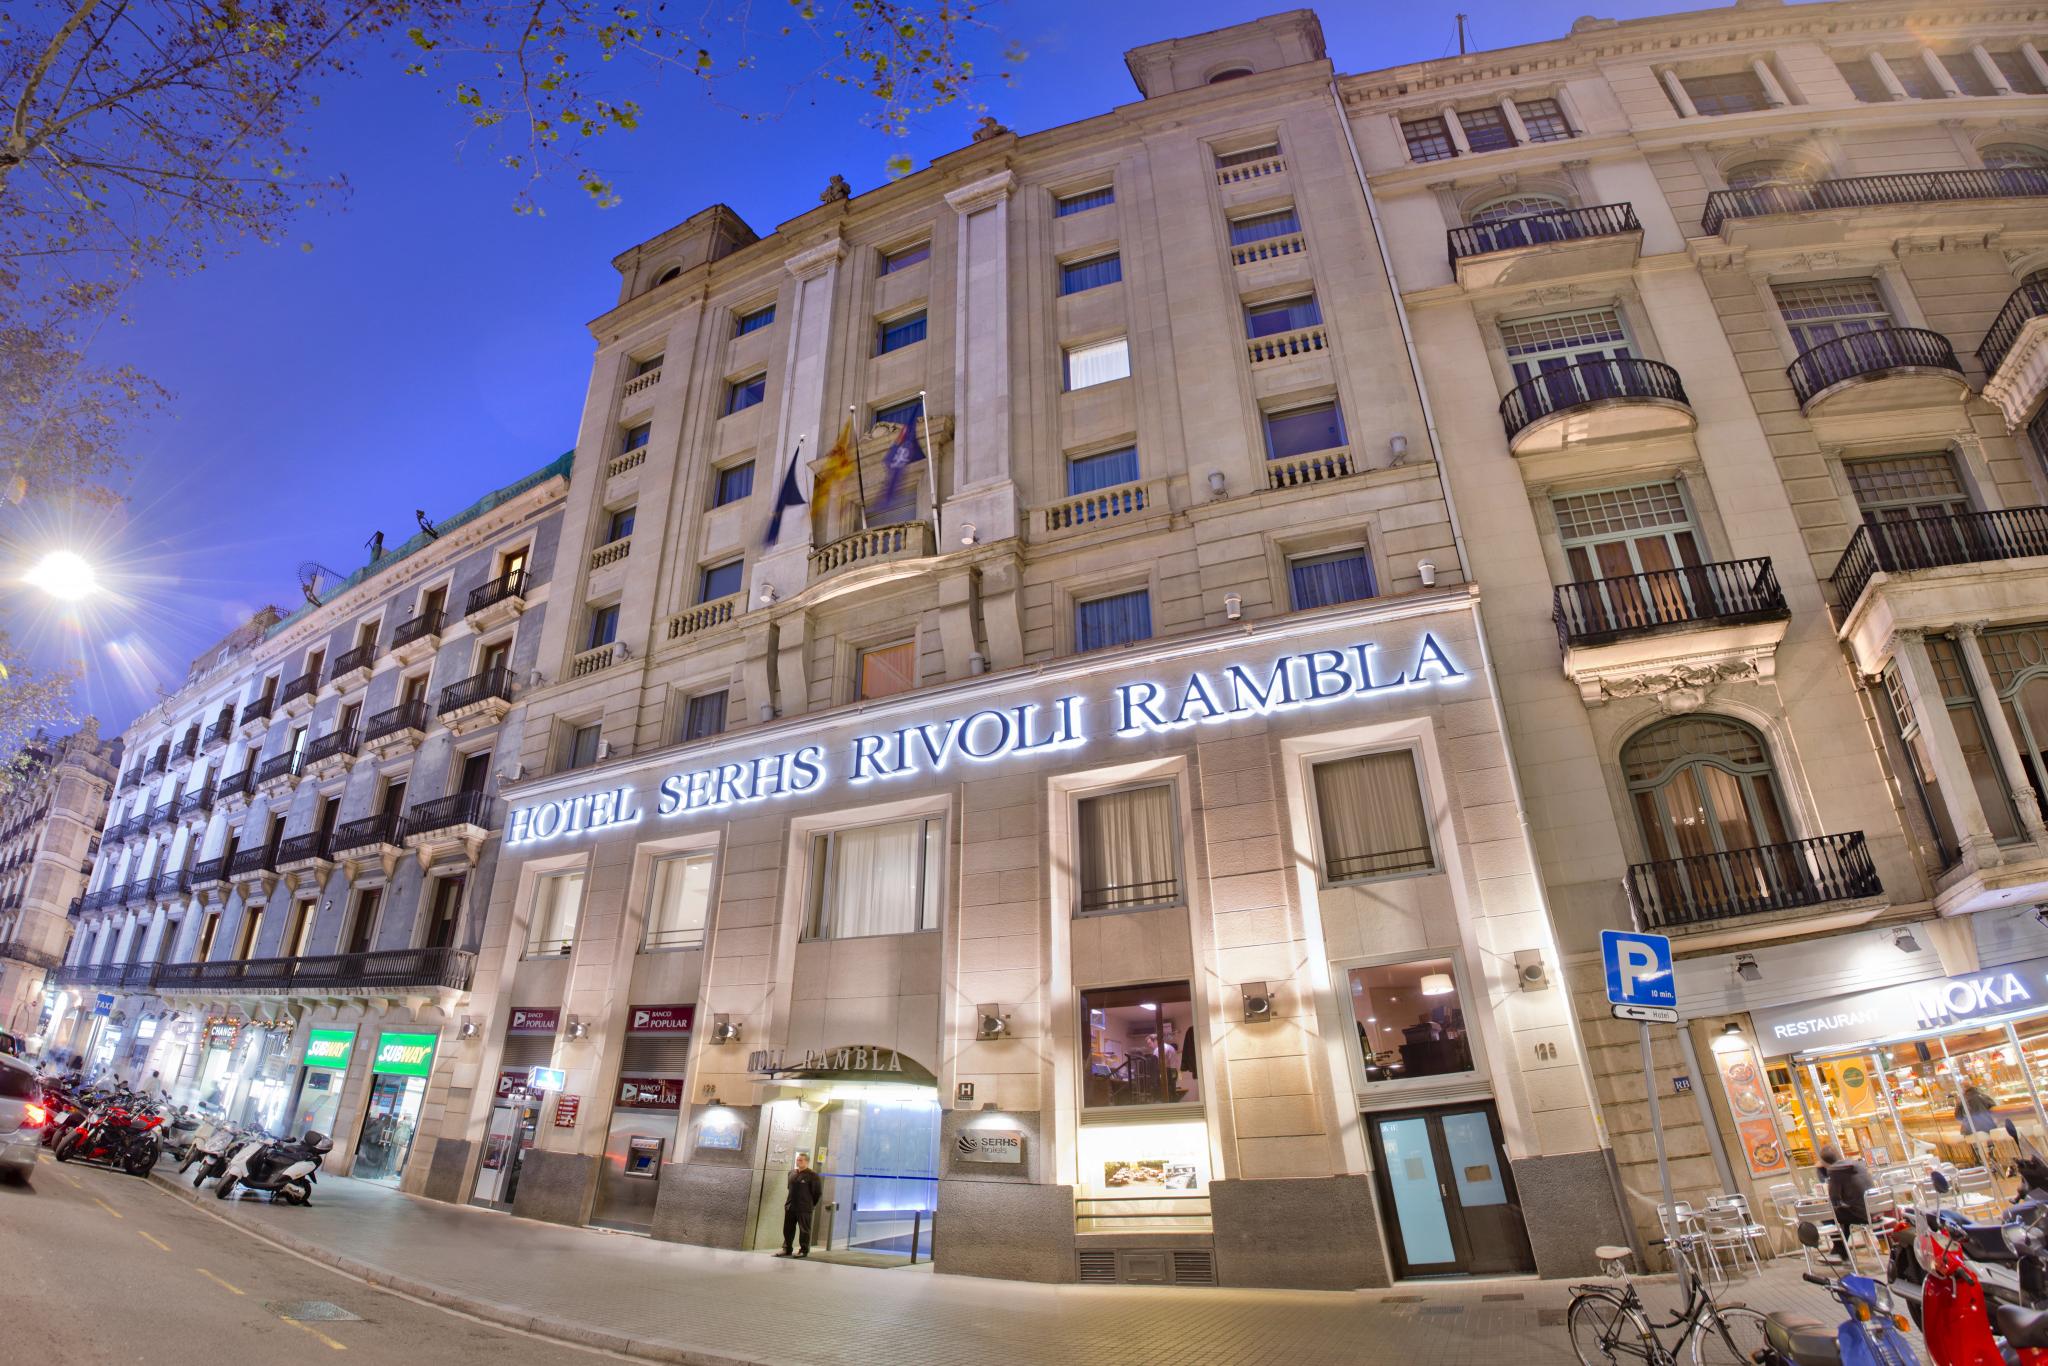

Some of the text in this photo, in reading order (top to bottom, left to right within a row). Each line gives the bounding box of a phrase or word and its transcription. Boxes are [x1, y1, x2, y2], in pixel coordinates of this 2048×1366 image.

[505, 632, 1467, 846] HOTEL SERHS RIVOLI RAMBLA
[1616, 939, 1659, 997] P
[1651, 989, 1659, 998] 10
[1908, 972, 2031, 1022] MOKA
[95, 1000, 114, 1010] TAXI
[525, 1020, 555, 1028] POPULAR
[650, 1019, 687, 1028] POPULAR
[1773, 1007, 1880, 1039] RESTAURANT
[307, 1039, 350, 1058] SUBWAY
[378, 1044, 432, 1064] SUBWAY
[800, 1049, 903, 1073] RAMBLA
[512, 1087, 542, 1096] POULAR
[640, 1084, 661, 1092] BANCO
[961, 1083, 972, 1096] H
[981, 1137, 1018, 1147] SERHS
